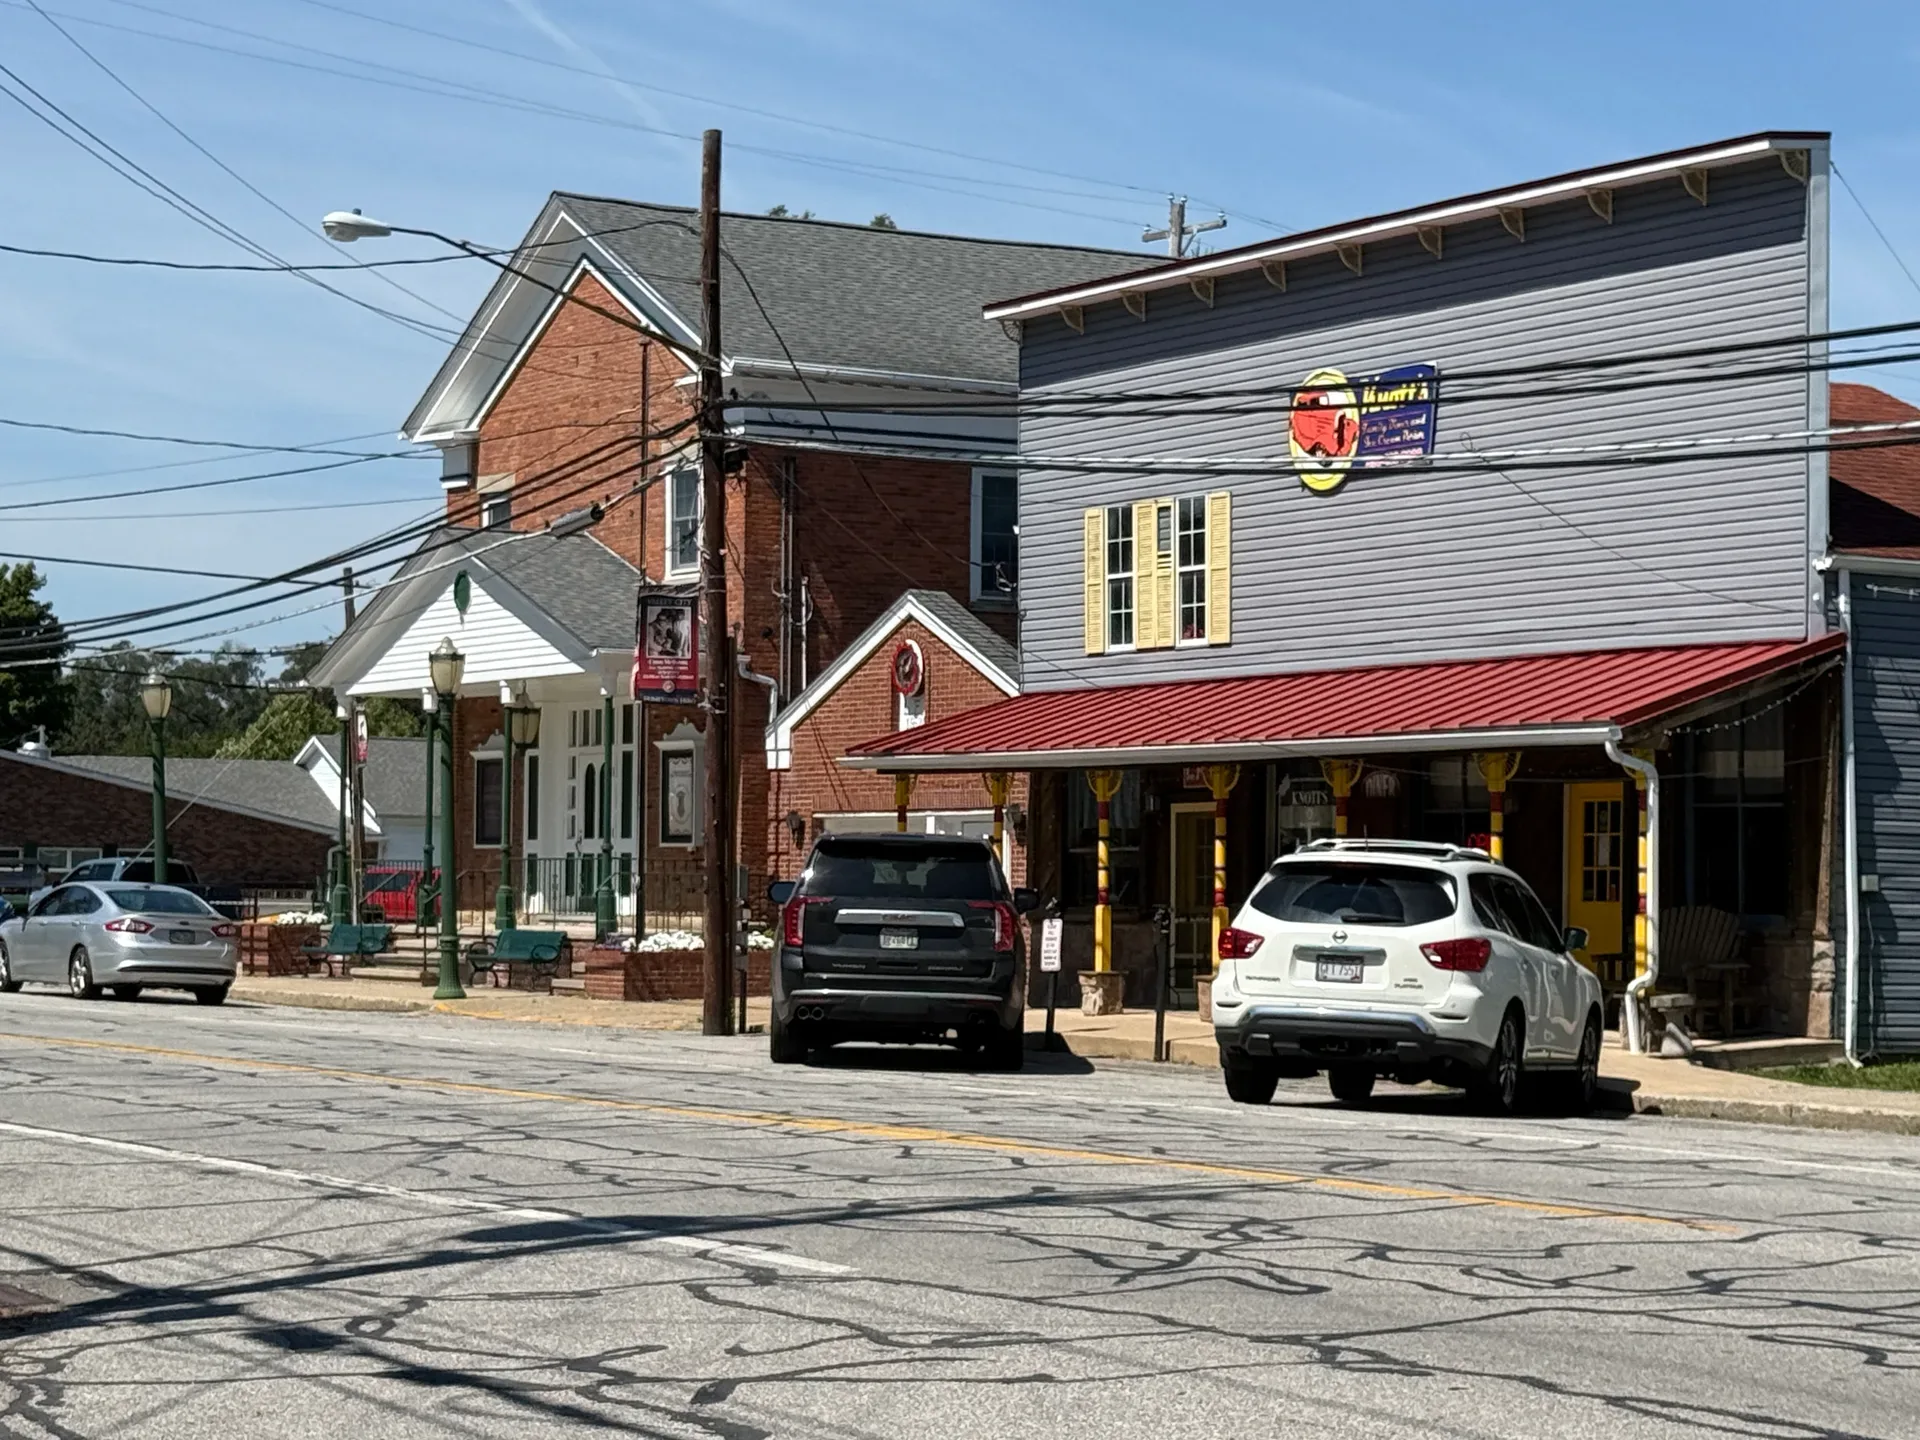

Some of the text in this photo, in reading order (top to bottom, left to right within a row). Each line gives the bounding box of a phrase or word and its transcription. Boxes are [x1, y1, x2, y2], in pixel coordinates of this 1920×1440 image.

[1410, 413, 1427, 426] and
[1378, 434, 1401, 446] Cream
[1365, 773, 1397, 798] DINER
